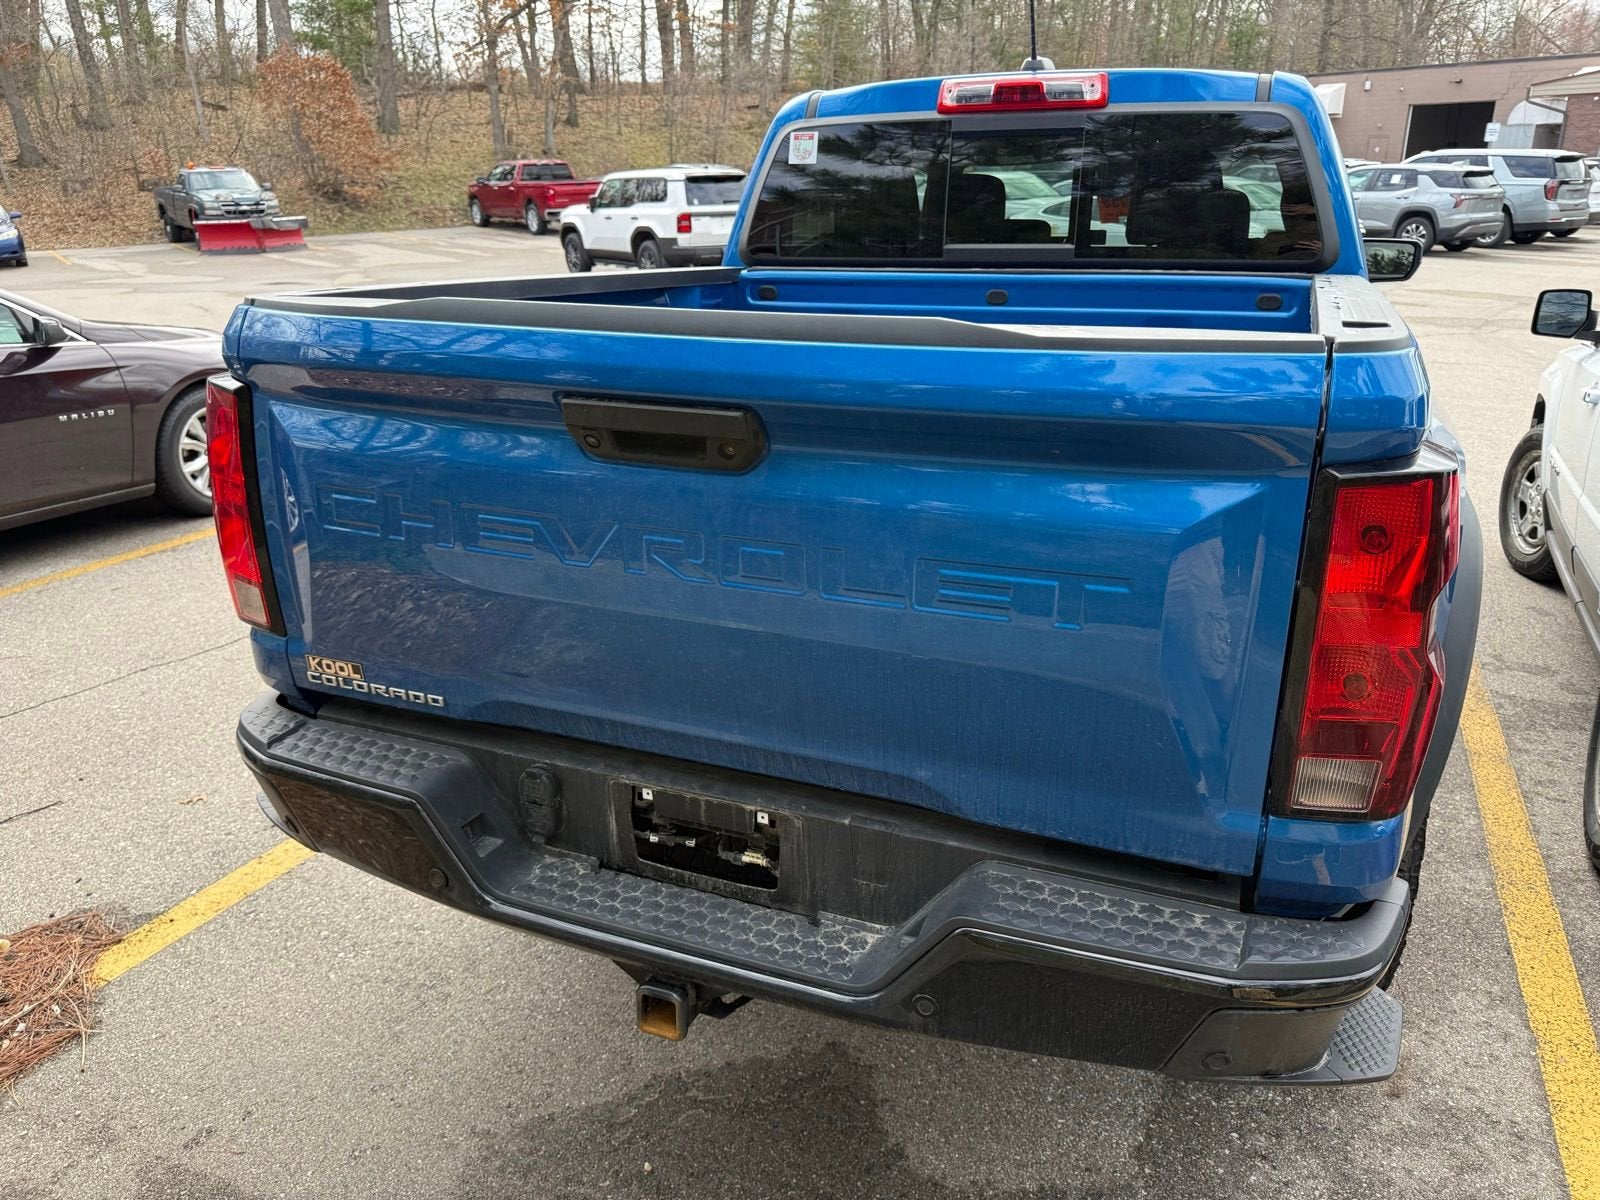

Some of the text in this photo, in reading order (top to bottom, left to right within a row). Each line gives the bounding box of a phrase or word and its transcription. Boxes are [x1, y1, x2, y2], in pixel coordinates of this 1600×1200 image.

[58, 408, 115, 422] MALIBU
[315, 483, 1131, 631] CHEVROLET
[307, 655, 362, 680] KOOL
[306, 671, 444, 707] COLORADO
